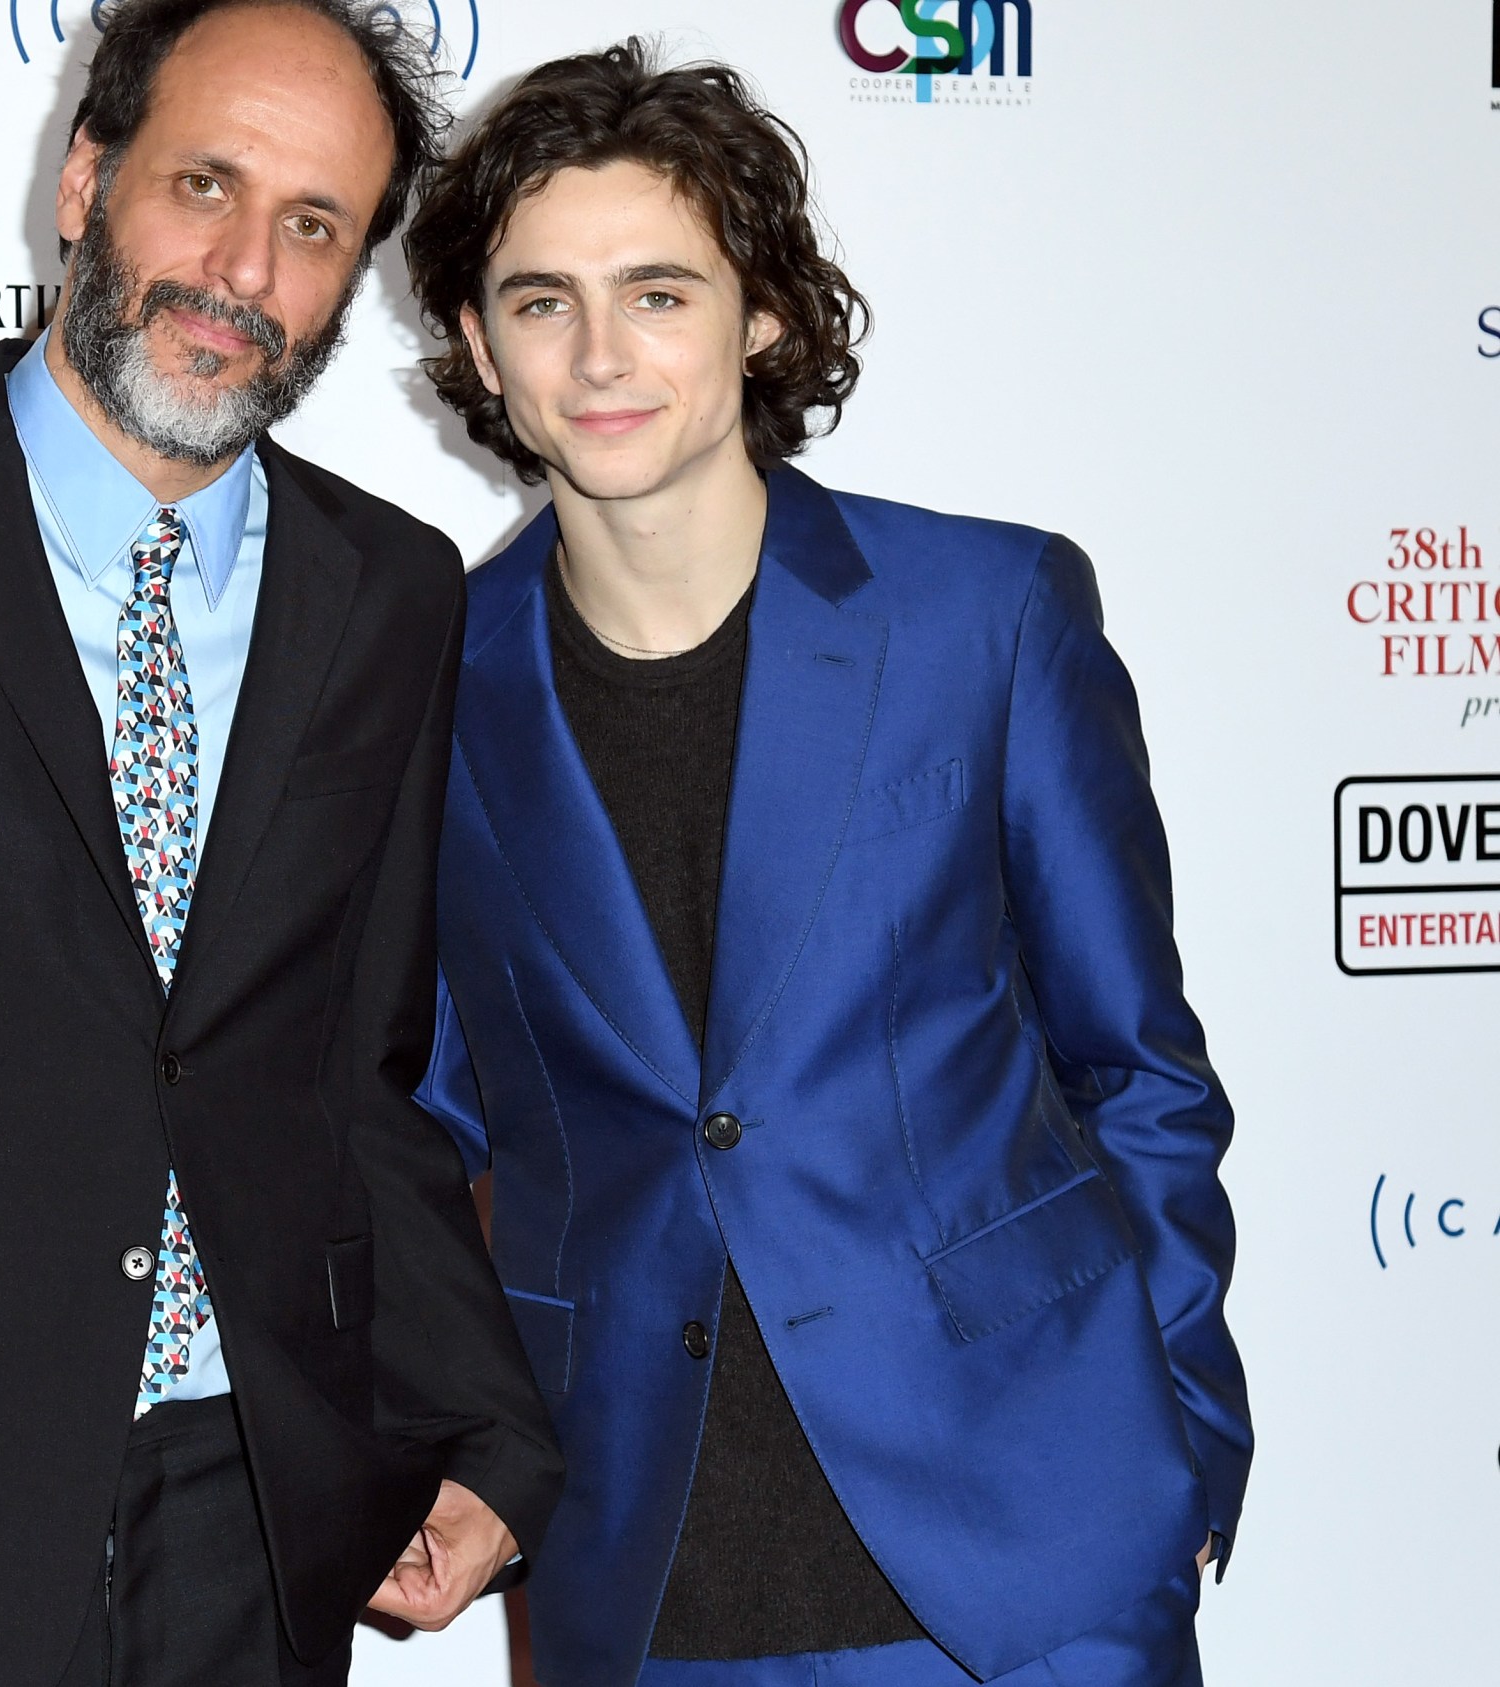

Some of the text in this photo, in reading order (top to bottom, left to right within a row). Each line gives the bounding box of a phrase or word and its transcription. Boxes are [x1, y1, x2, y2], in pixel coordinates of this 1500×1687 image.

[850, 78, 1032, 93] COOPER SEARLE
[850, 94, 913, 104] PERSONAL
[1387, 525, 1483, 570] 38th
[1347, 580, 1500, 624] CRITI
[1461, 696, 1500, 728] pr
[1360, 912, 1500, 948] ENTERTA
